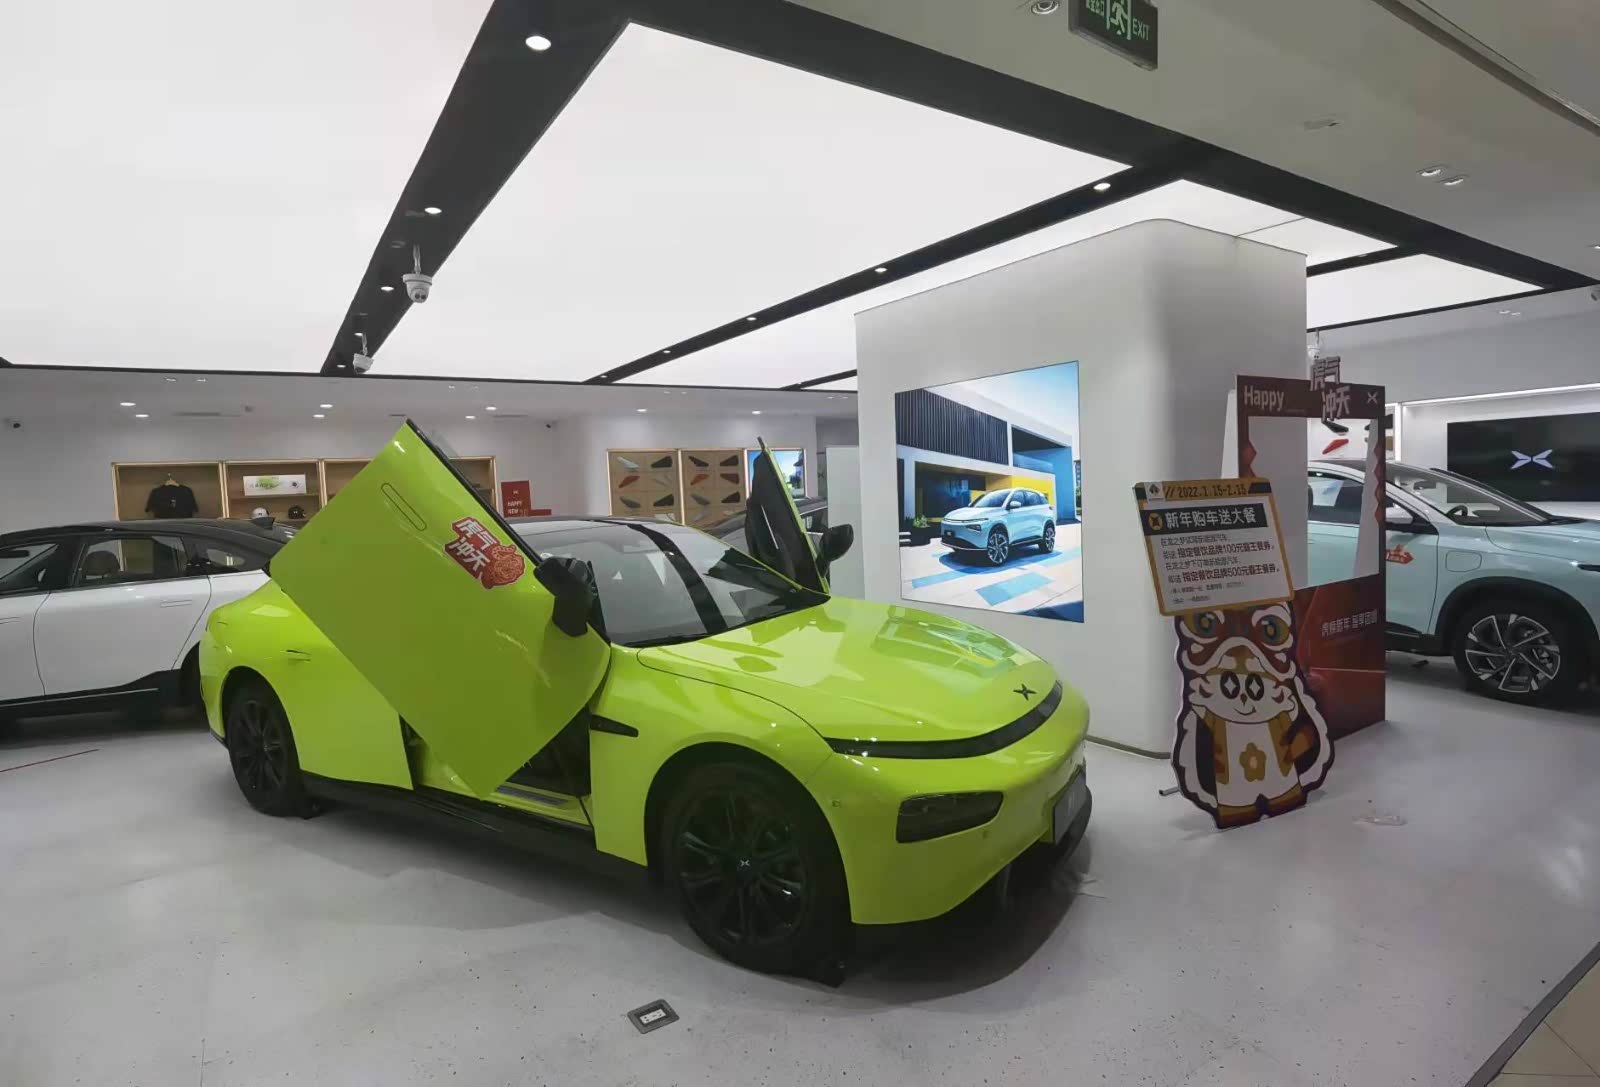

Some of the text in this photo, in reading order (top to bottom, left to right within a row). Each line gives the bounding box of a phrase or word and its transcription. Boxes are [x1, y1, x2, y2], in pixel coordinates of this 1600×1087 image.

[1132, 18, 1150, 40] EXIT
[1244, 385, 1285, 411] Happy
[1321, 386, 1350, 421] 冲天
[1165, 507, 1256, 529] 新年购车送大餐
[448, 537, 491, 572] 冲天
